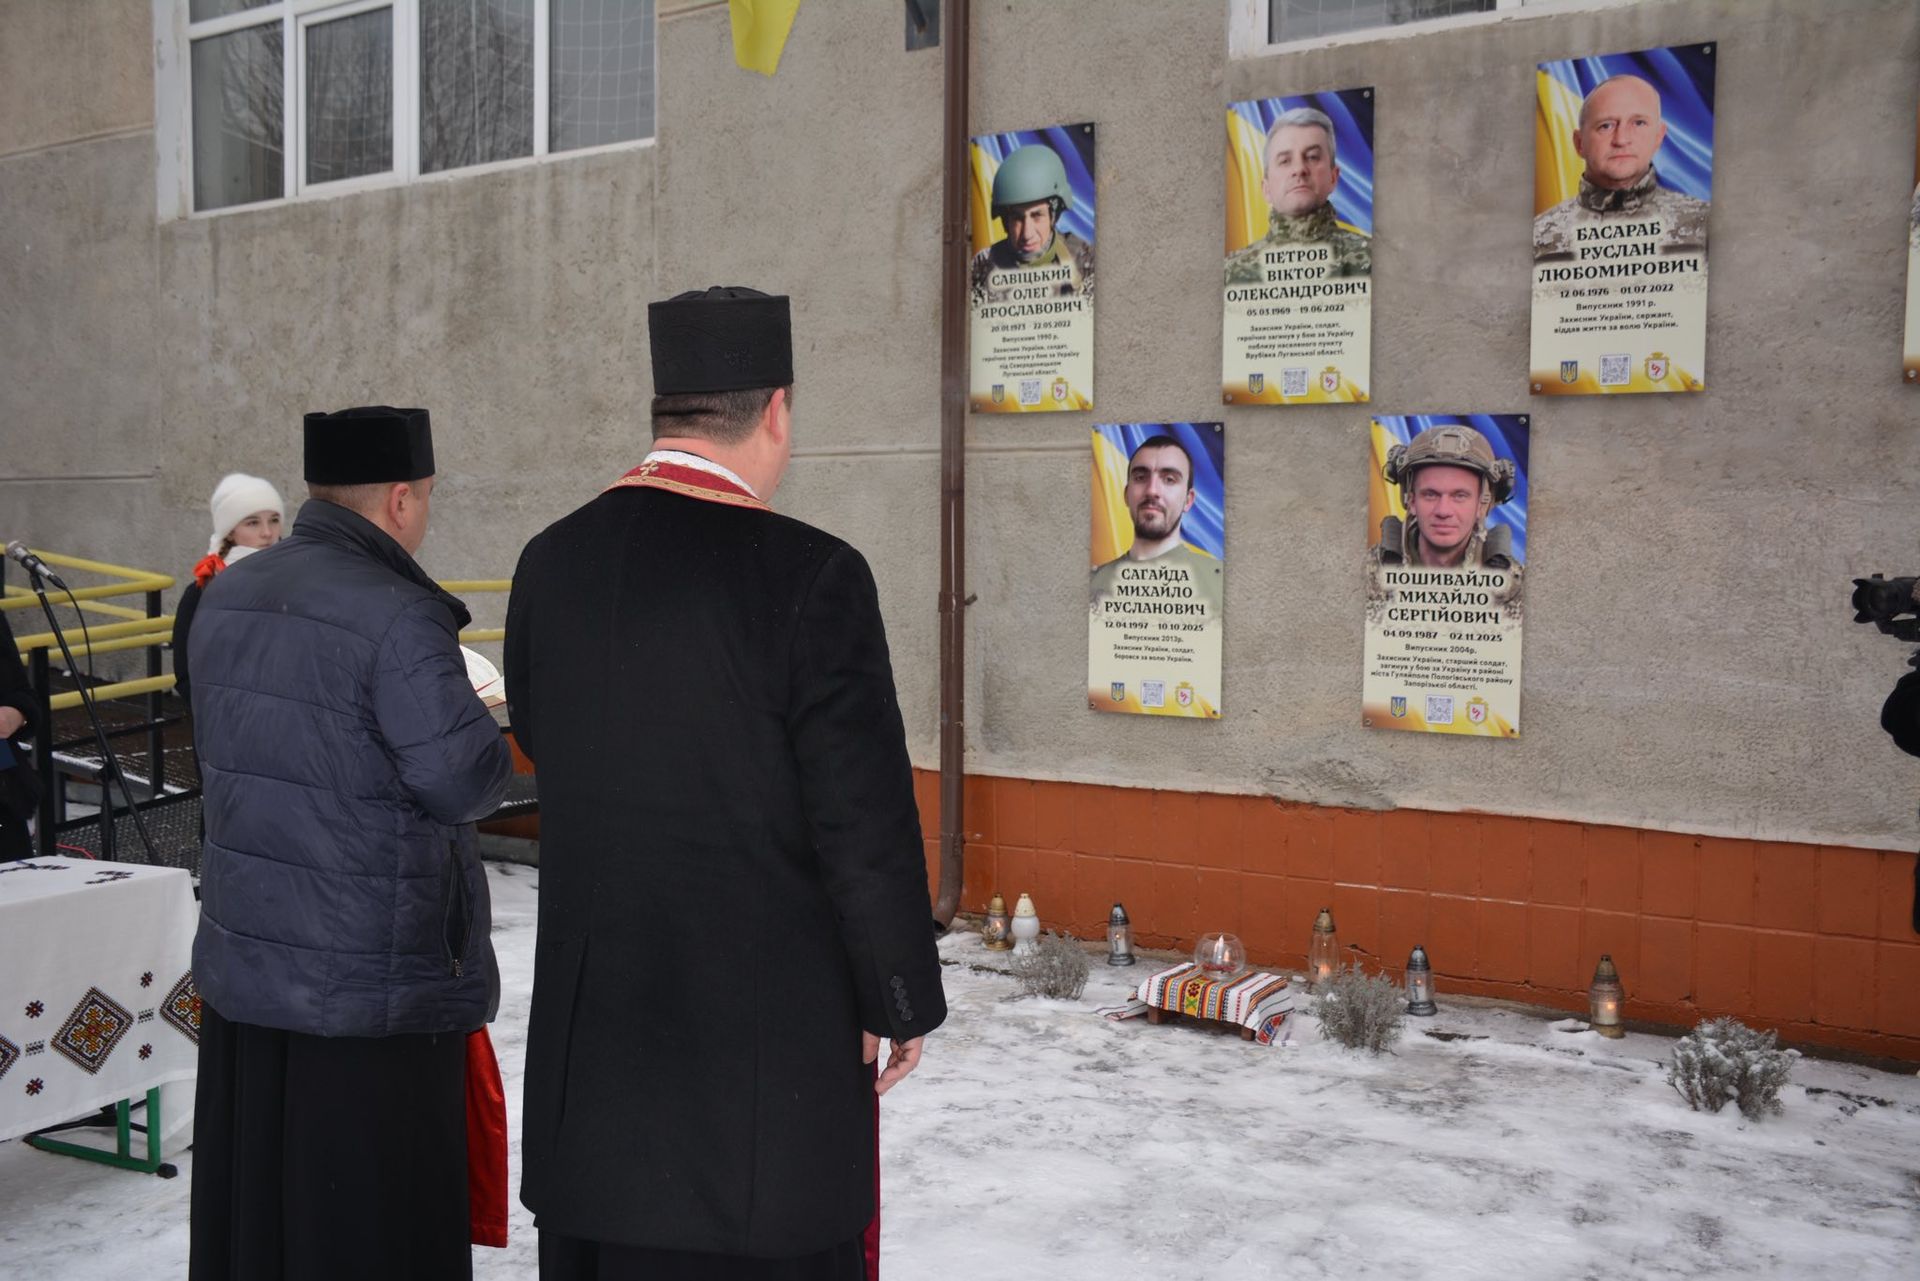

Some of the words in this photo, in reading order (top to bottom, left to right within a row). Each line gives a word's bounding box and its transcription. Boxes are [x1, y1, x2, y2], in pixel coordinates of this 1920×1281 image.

[1577, 221, 1661, 241] БАСАРАБ
[1265, 248, 1328, 265] ПЕТРОВ
[1580, 243, 1656, 260] РУСЛАН
[992, 266, 1071, 287] САВІЦЬКИЙ
[1267, 267, 1325, 282] ВІКТОР
[1539, 259, 1699, 283] ЛЮБОМИРОВИЧ
[1013, 287, 1049, 300] ОЛЕГ
[1227, 282, 1367, 302] ОЛЕКСАНДРОВИЧ
[981, 300, 1082, 319] ЯРОСЛАВОВИЧ
[1576, 302, 1622, 312] Випускник
[1626, 300, 1646, 308] 1991
[1560, 314, 1597, 323] Захисник
[1599, 313, 1633, 322] України,
[1284, 323, 1313, 332] України,
[1554, 326, 1580, 334] віддав
[1642, 321, 1678, 330] України.
[1002, 335, 1035, 344] Випускник
[1237, 333, 1266, 341] героїчно
[1248, 342, 1276, 350] поблизу
[1278, 350, 1315, 358] Луганської
[1122, 566, 1189, 583] САГАЙДА
[1386, 571, 1504, 588] ПОШИВАЙЛО
[1117, 583, 1192, 598] МИХАЙЛО
[1399, 589, 1489, 606] МИХАЙЛО
[1105, 602, 1205, 615] РУСЛАНОВИЧ
[1388, 607, 1500, 624] СЕРГІЙОВИЧ
[1405, 644, 1447, 652] Випускник
[1450, 645, 1477, 654] 2004р.
[1377, 654, 1410, 662] Захисник
[1413, 655, 1444, 664] України,
[1446, 657, 1478, 666] старший
[1380, 663, 1408, 671] загинув
[1442, 665, 1470, 674] Україну
[1391, 671, 1429, 679] Гуляйполе
[1431, 672, 1484, 682] Пологівського
[1486, 675, 1512, 684] району
[1404, 680, 1446, 689] Запорізької
[1448, 681, 1478, 690] області.
